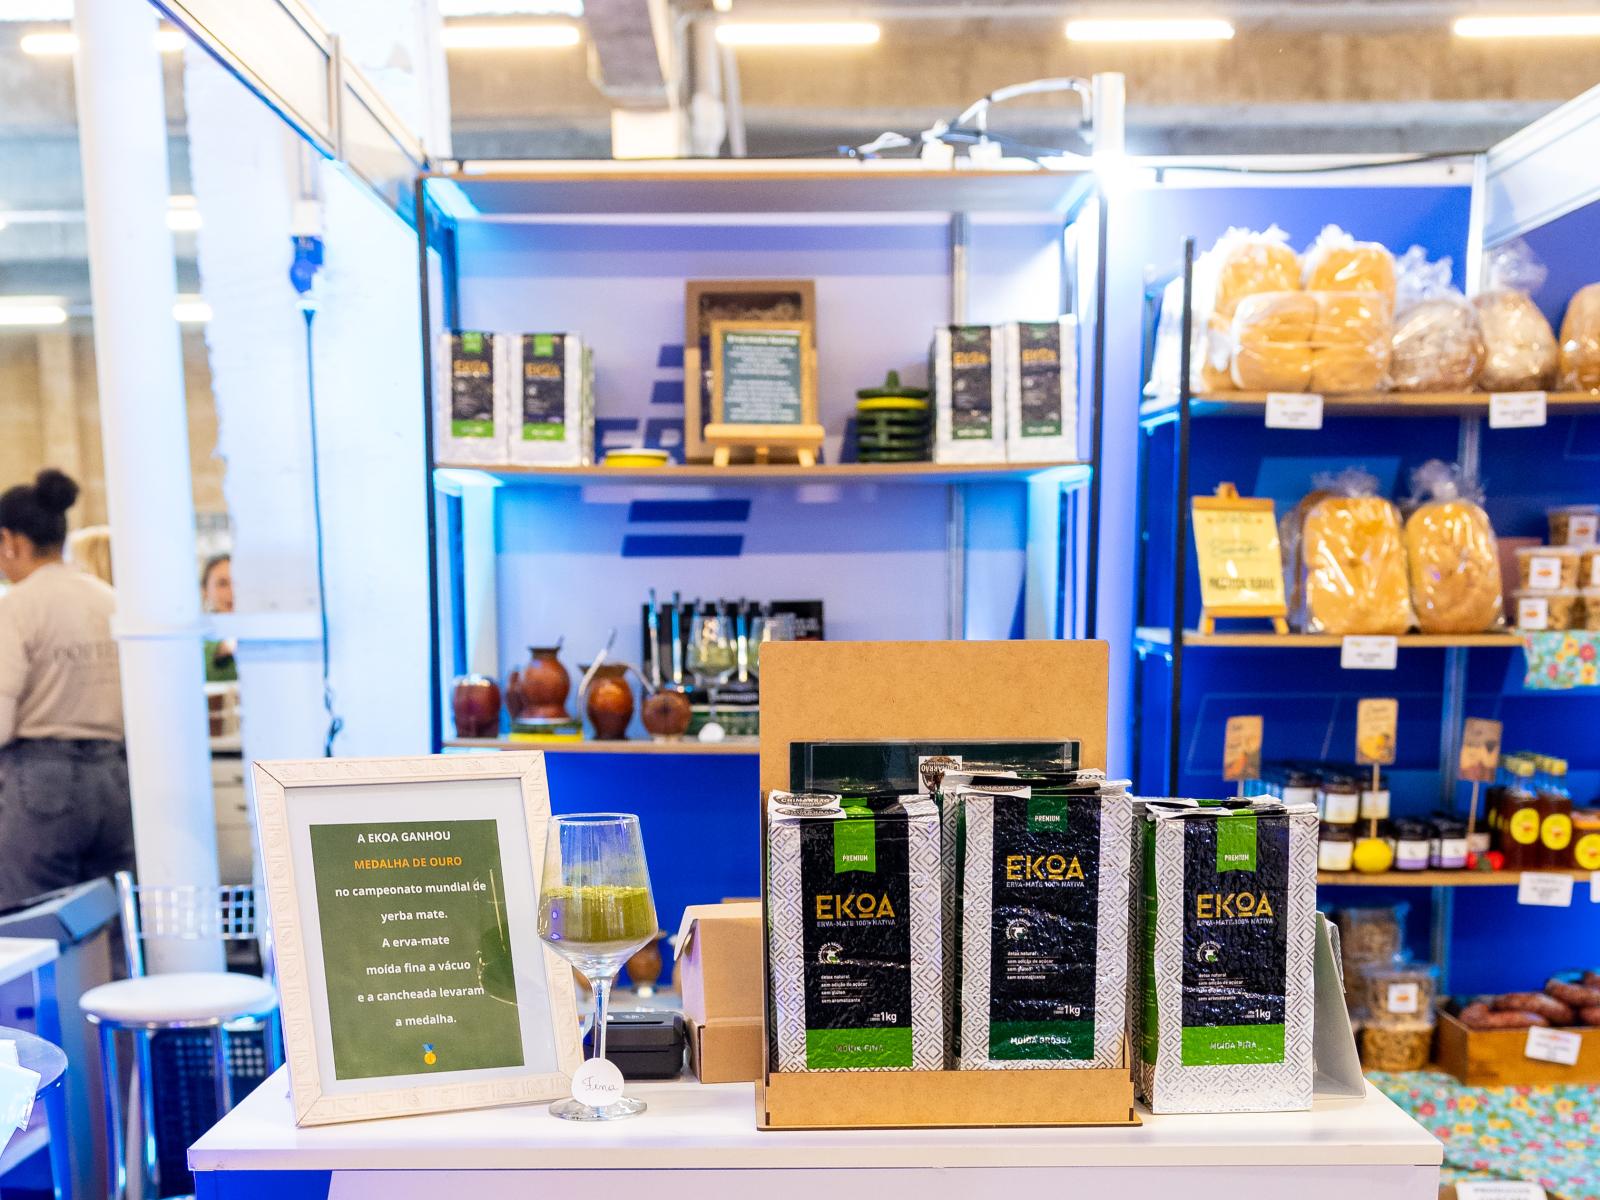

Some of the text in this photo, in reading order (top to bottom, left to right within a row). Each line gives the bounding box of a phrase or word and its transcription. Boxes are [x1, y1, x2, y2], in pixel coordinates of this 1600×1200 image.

[357, 831, 451, 843] A EKOA GANHOU
[354, 856, 462, 870] MEDALHA DE OURO
[842, 853, 869, 862] PREMIUM
[1224, 854, 1249, 862] PREMIUM
[1006, 854, 1085, 880] EKOA
[335, 881, 487, 898] no campeonato mundial de
[815, 893, 895, 920] EKOA
[1197, 892, 1274, 919] EKOA
[380, 909, 448, 924] yerba mate.
[816, 920, 854, 928] ERVA-MATE
[872, 918, 896, 926] NATIVA
[1196, 919, 1232, 927] ERVA-MATE
[382, 936, 450, 948] A erva-mate
[366, 960, 471, 975] moída fina a vácuo
[357, 986, 485, 1003] e a cancheada levaram
[1064, 1004, 1081, 1017] 1kg
[1255, 1008, 1271, 1021] 1kg
[405, 1014, 457, 1026] medalha.
[880, 1011, 897, 1024] 1kg
[1039, 1036, 1072, 1045] GROSSA
